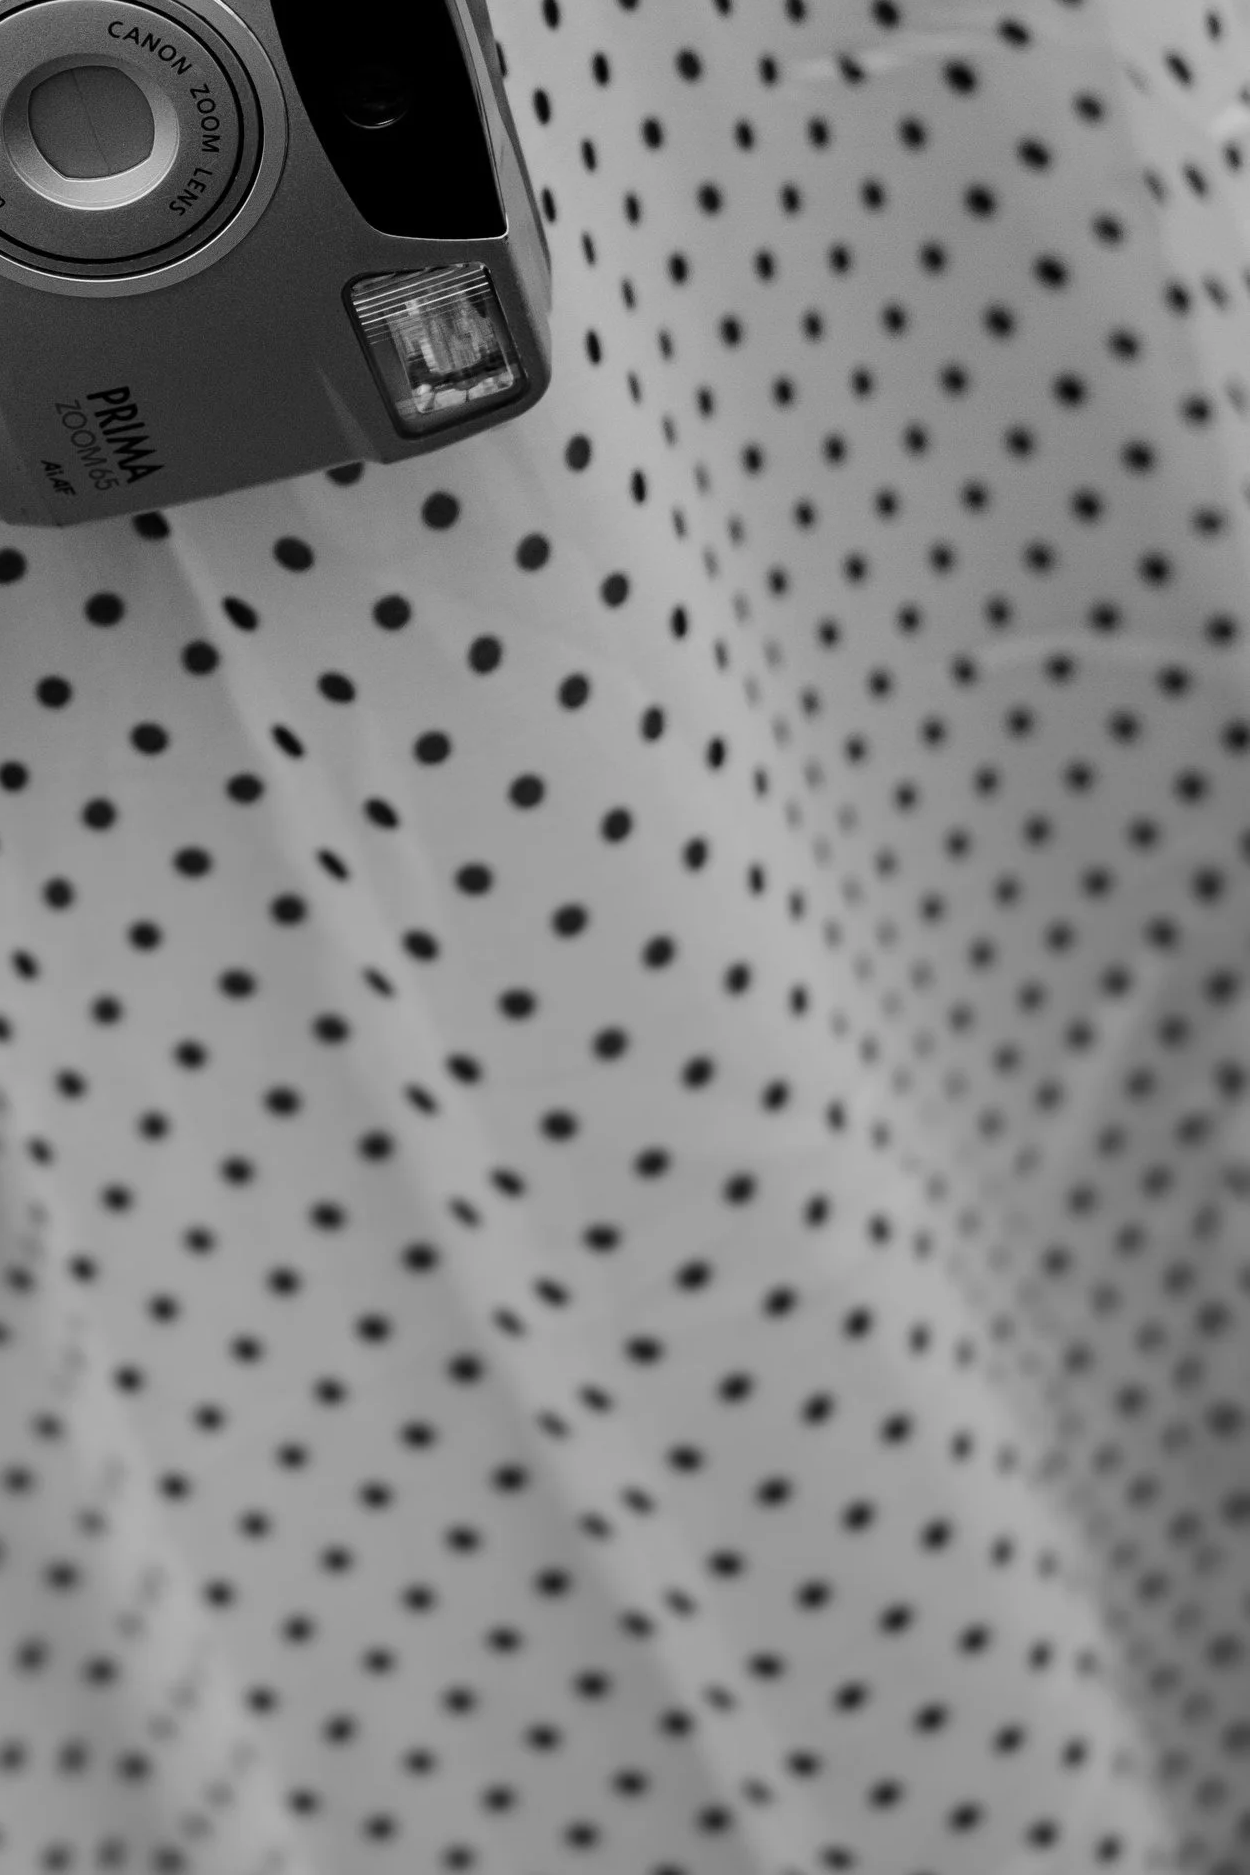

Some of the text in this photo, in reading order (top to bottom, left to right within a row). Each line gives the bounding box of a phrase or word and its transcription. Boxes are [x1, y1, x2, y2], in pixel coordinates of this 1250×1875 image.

[107, 20, 222, 216] CANON ZOOM LENS
[86, 386, 165, 483] PRIMA
